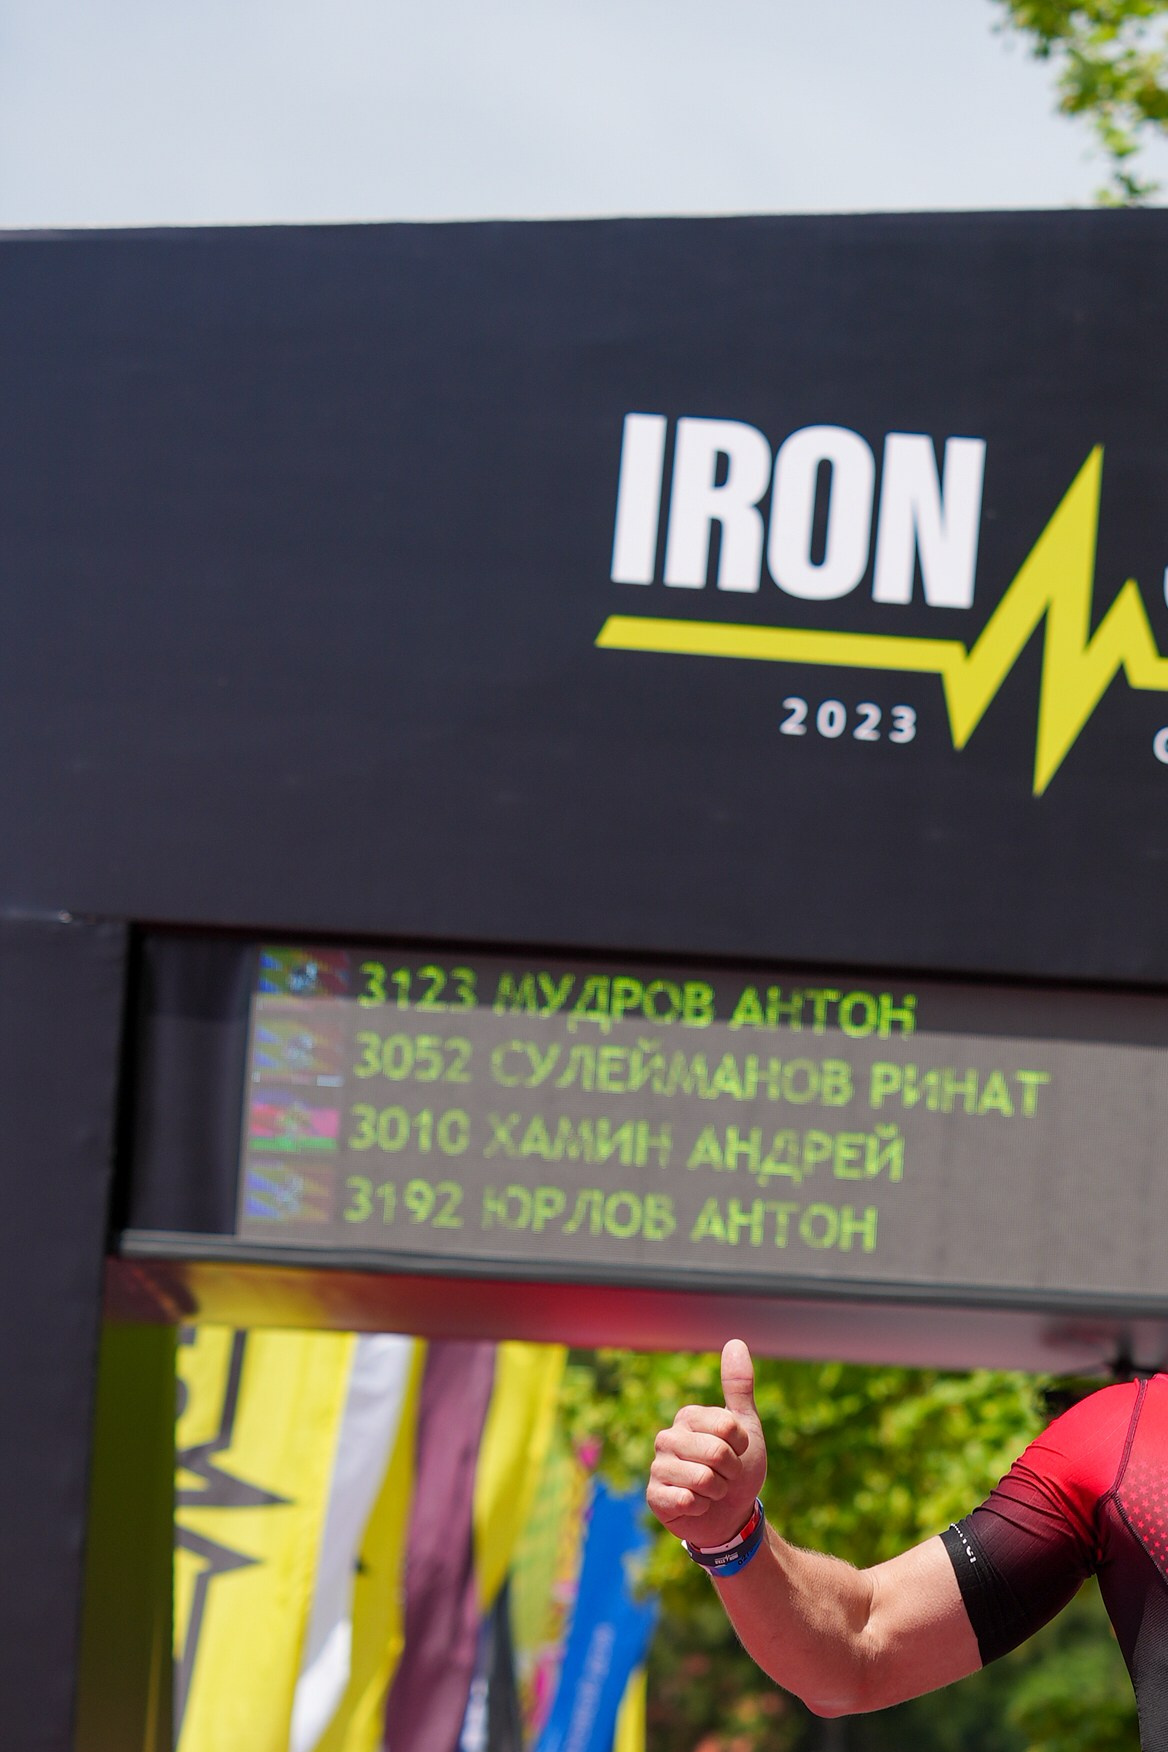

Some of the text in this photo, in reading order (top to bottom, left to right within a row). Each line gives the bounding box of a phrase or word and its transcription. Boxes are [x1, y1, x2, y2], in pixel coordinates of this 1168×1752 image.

[611, 412, 987, 610] IRON
[779, 697, 918, 744] 2023
[359, 960, 479, 1012] 3123
[491, 970, 715, 1035] МУДРОВ
[727, 984, 919, 1041] АНТОН
[352, 1030, 474, 1084] 3052
[490, 1036, 854, 1108] СУЛЕЙМАНОВ
[868, 1061, 1050, 1119] РИНАТ
[347, 1104, 471, 1157] 3010
[483, 1112, 673, 1171] ХАМИН
[685, 1122, 906, 1188] АНДРЕЙ
[342, 1175, 465, 1230] 3192
[479, 1183, 677, 1242] ЮРЛОВ
[690, 1197, 879, 1254] АНТОН
